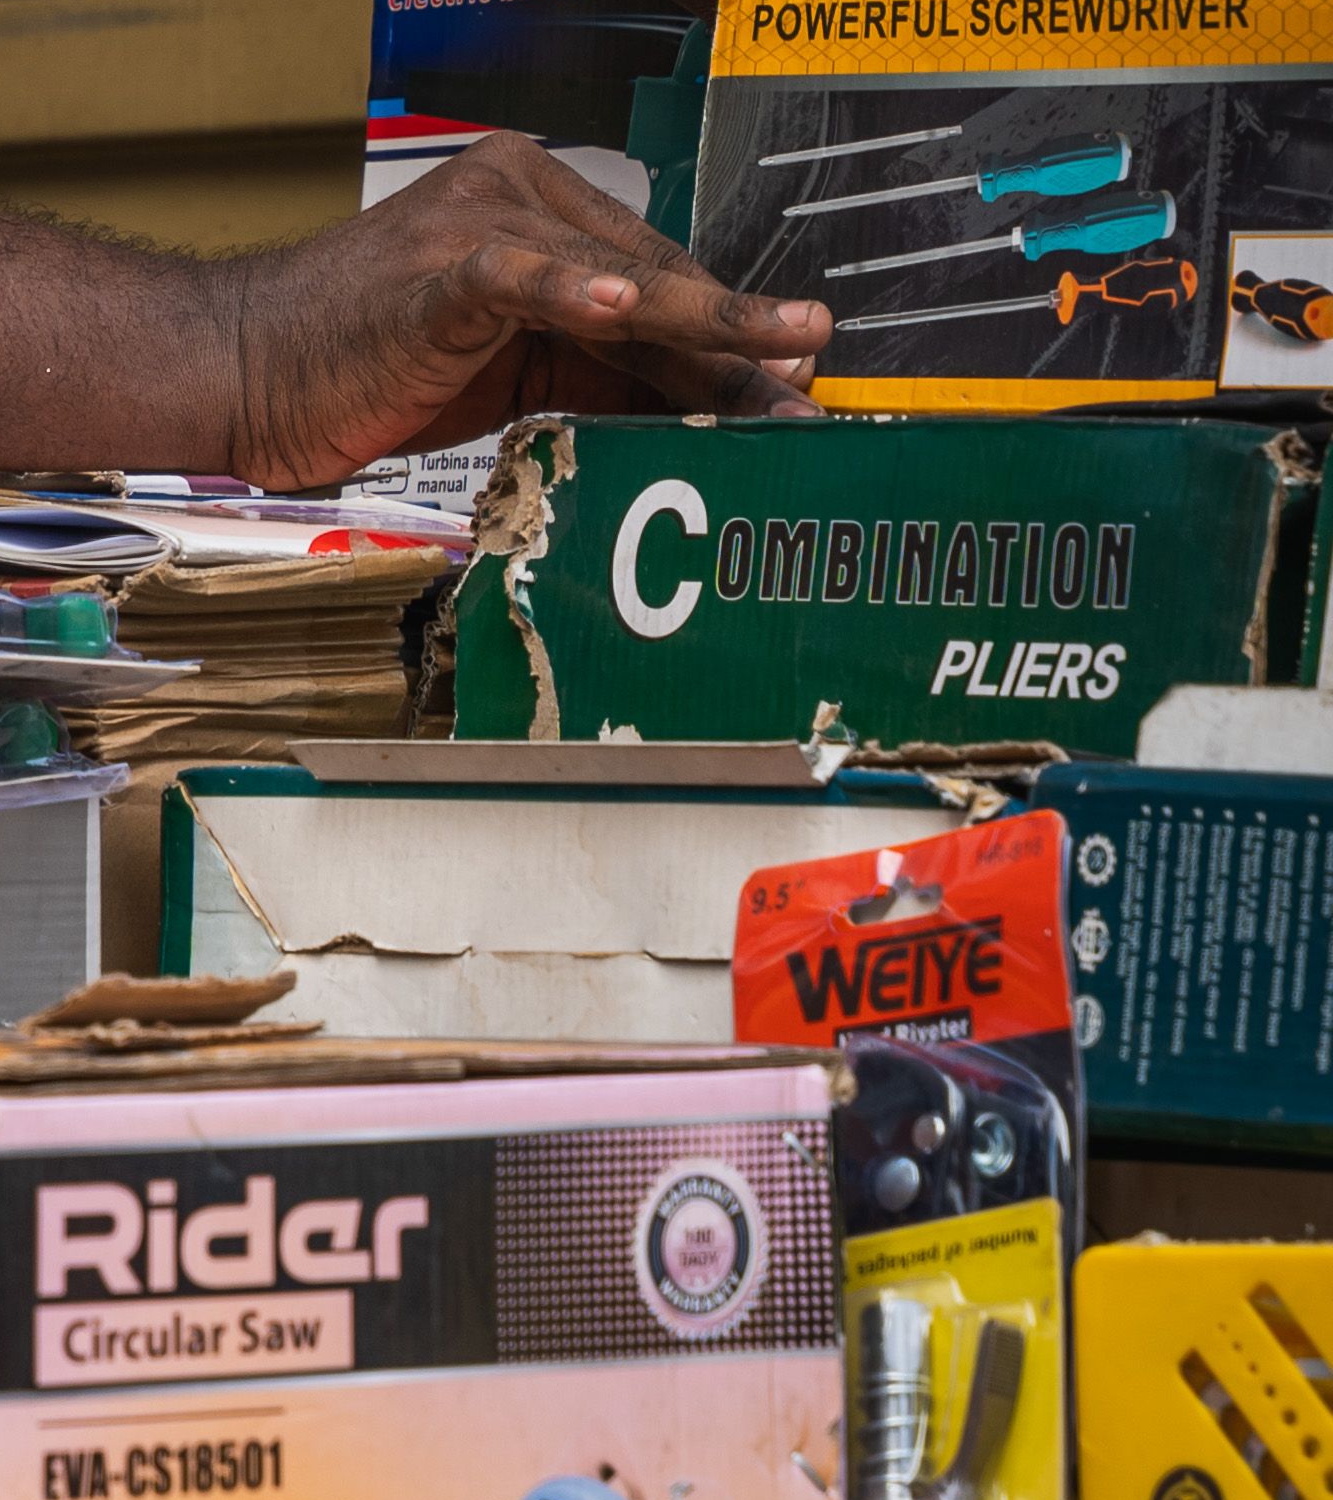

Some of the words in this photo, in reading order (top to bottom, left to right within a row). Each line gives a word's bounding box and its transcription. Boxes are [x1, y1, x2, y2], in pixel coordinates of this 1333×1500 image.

[417, 474, 468, 494] manual
[420, 451, 470, 472] Turbina
[608, 477, 1135, 642] COMBINATION
[930, 640, 1127, 701] PLIERS
[784, 916, 1004, 1023] WEIYE
[35, 1174, 430, 1300] Rider
[62, 1313, 227, 1364] Circular
[240, 1309, 322, 1353] Saw
